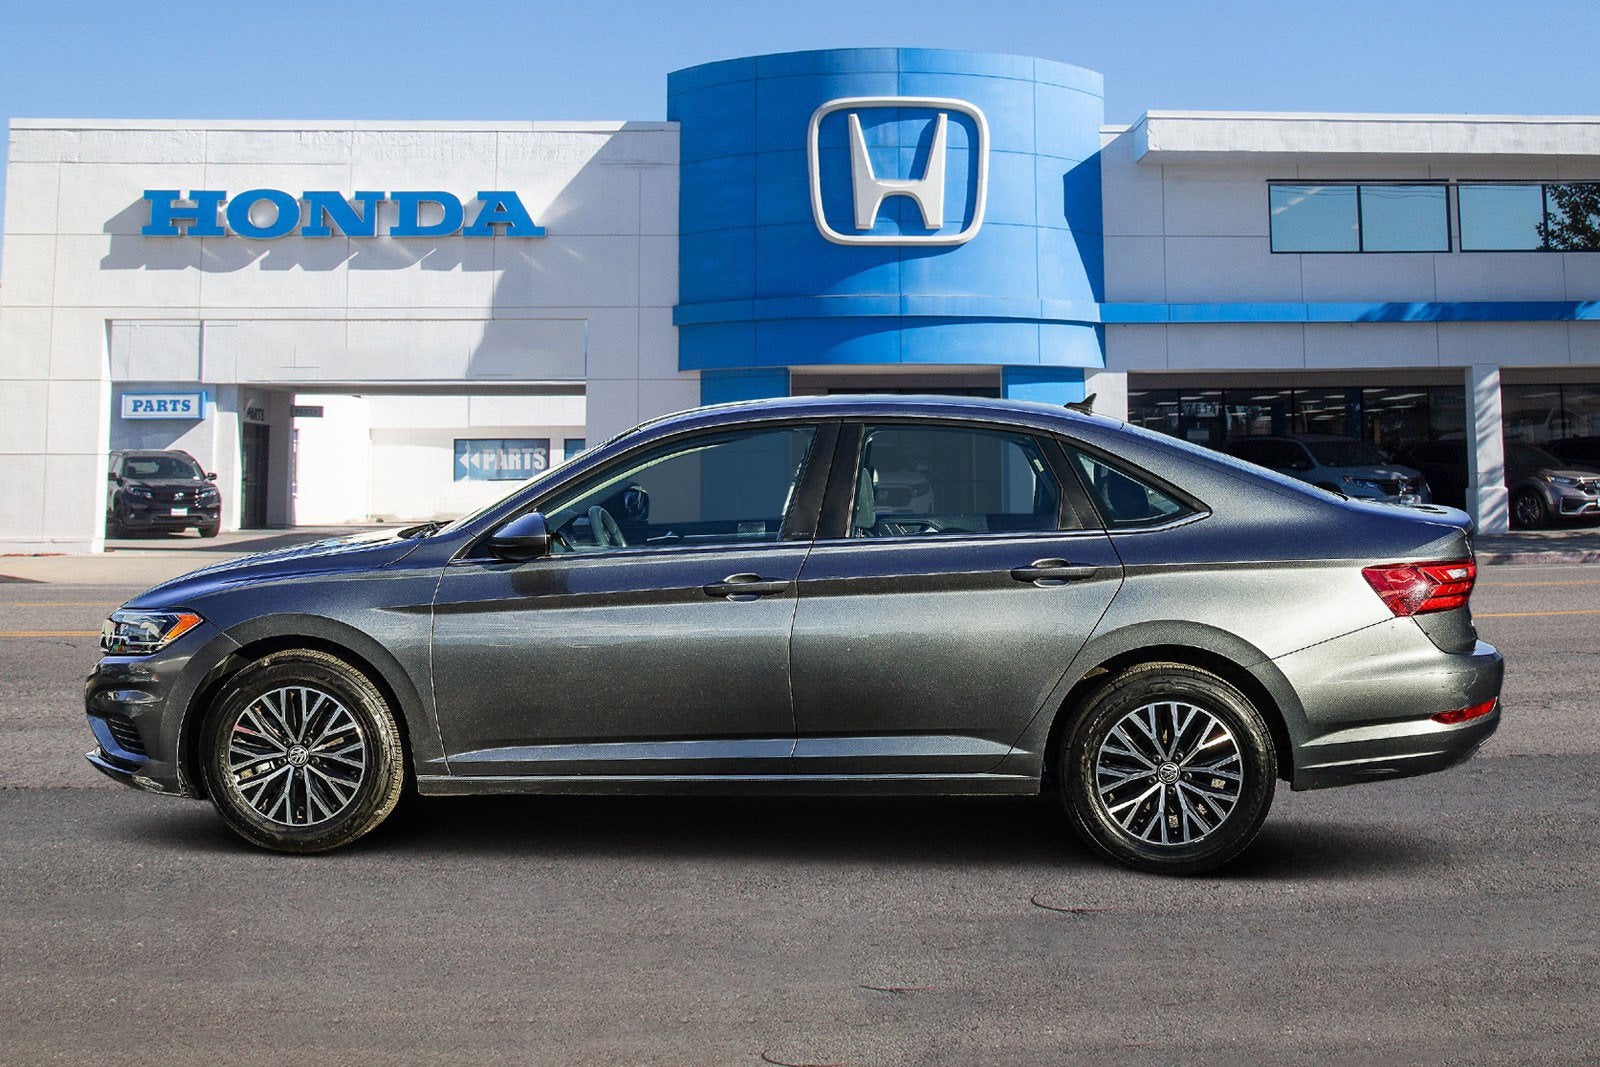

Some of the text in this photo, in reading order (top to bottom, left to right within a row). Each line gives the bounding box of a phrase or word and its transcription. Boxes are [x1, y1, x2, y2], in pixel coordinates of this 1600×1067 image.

[141, 188, 547, 240] HONDA
[132, 399, 191, 412] PARTS
[482, 447, 547, 470] PARTS
